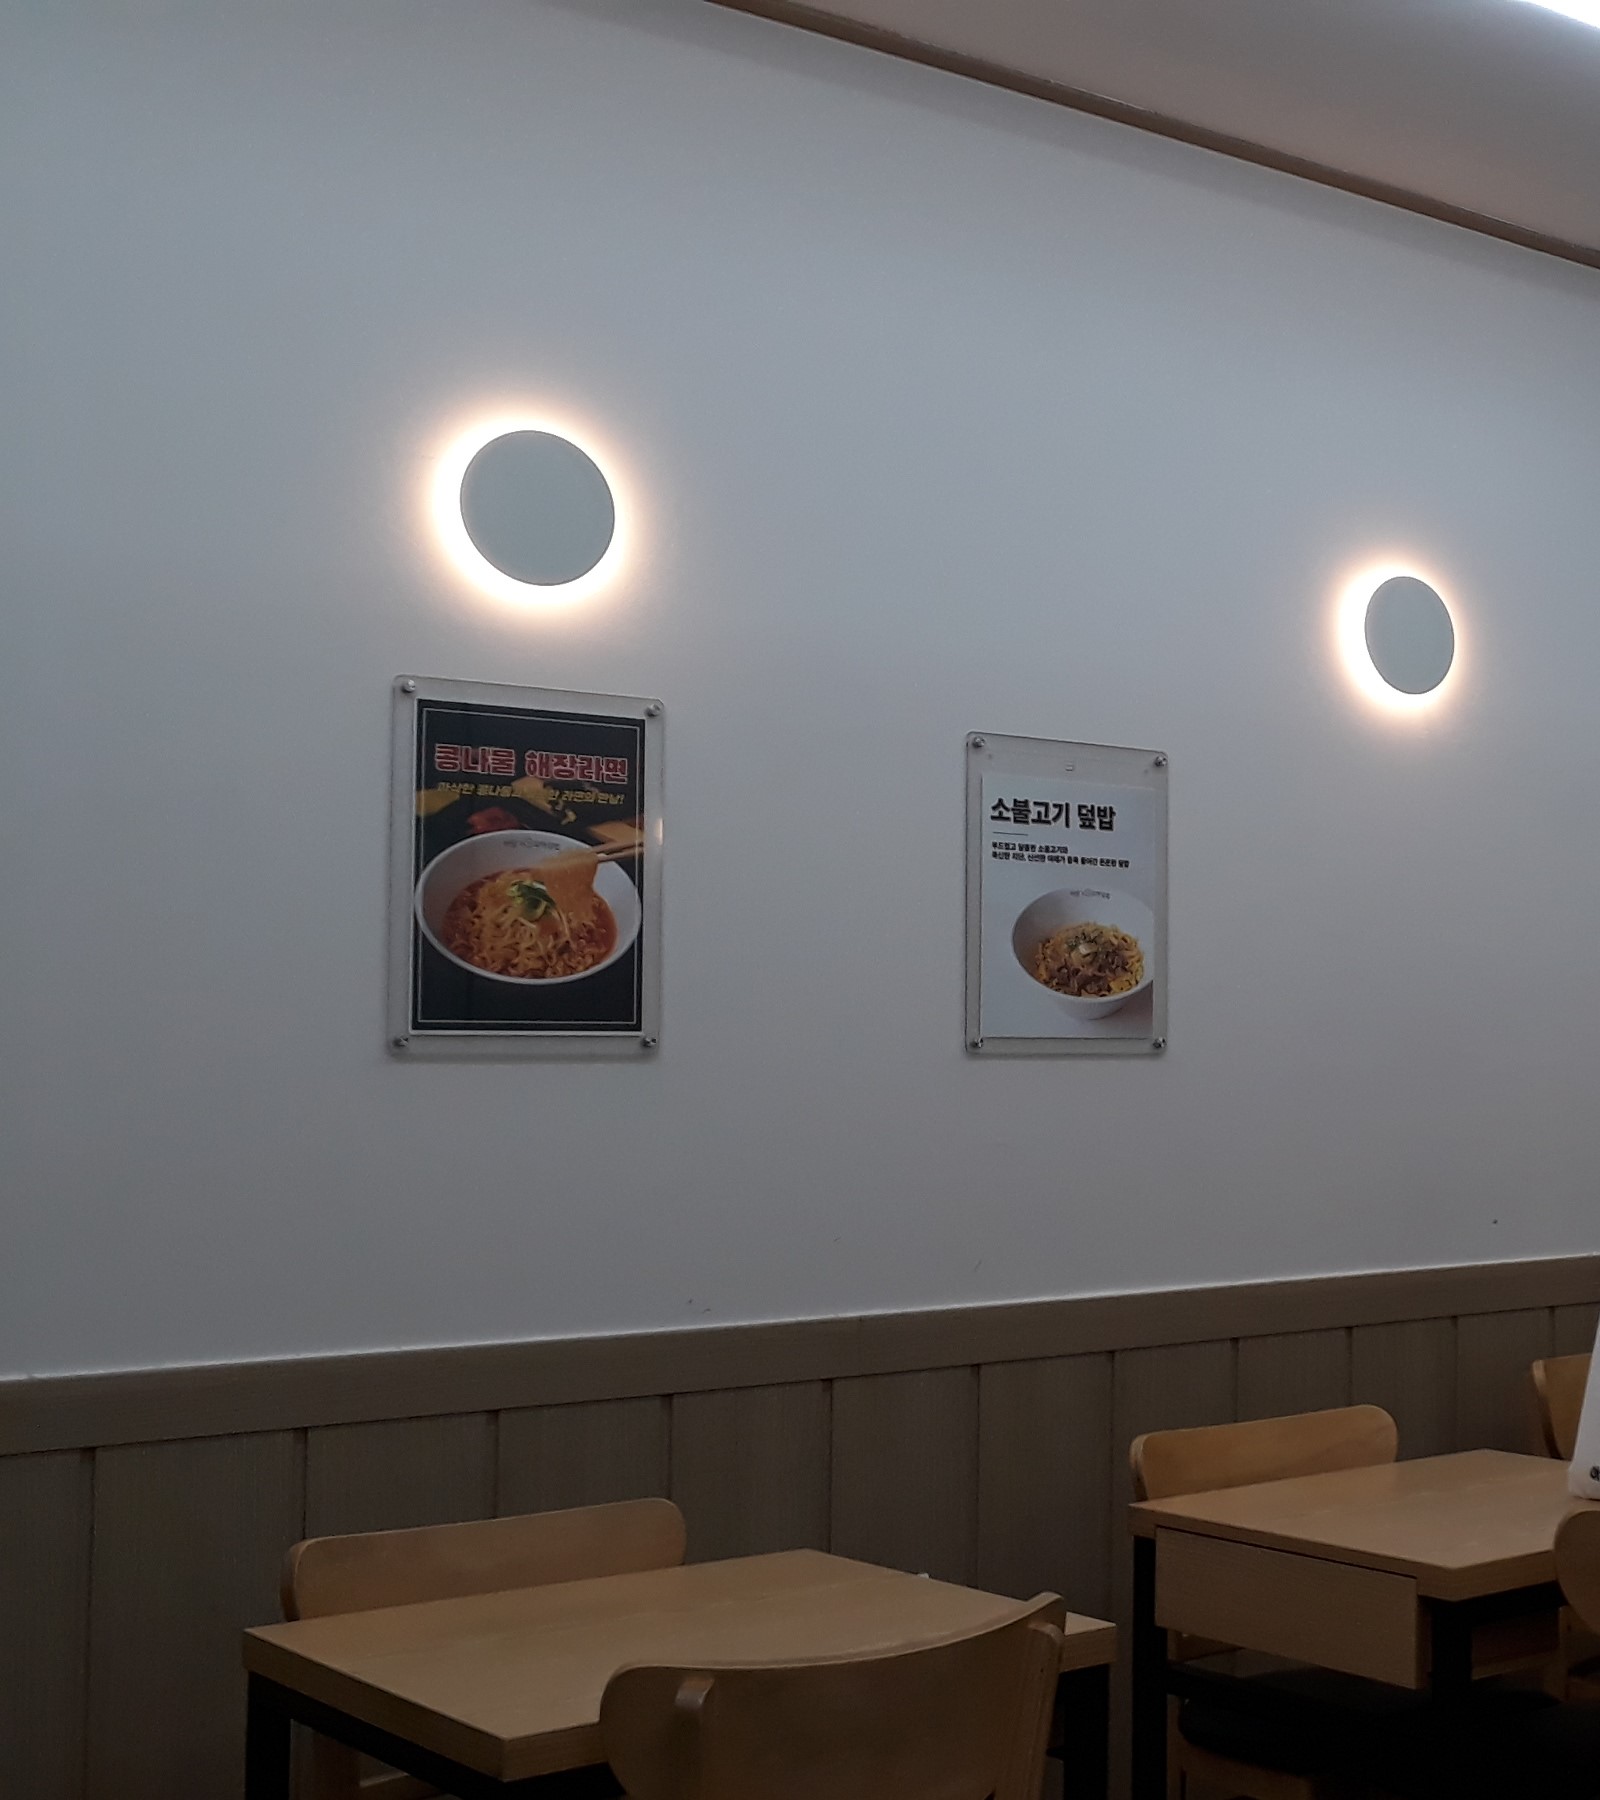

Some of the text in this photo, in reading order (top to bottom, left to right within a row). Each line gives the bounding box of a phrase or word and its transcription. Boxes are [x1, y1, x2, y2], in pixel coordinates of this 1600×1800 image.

[435, 743, 629, 785] 콩나물 해장라면
[990, 797, 1117, 832] 소불고기 덮밥
